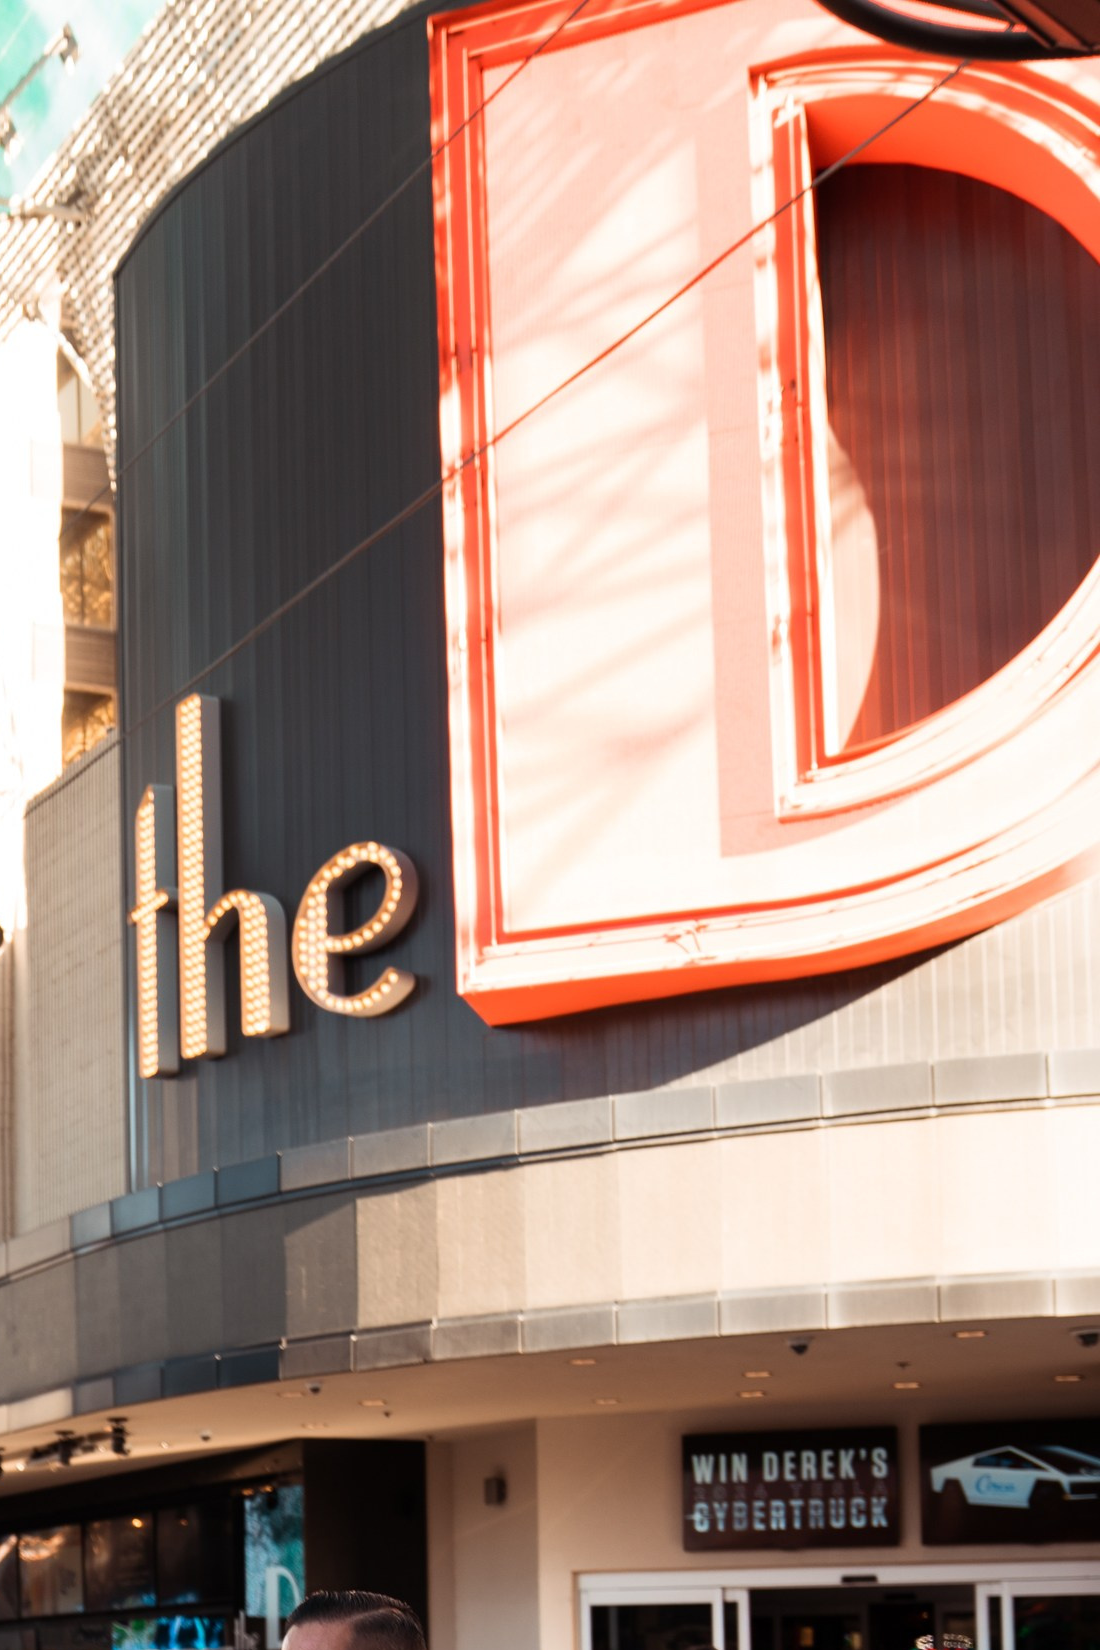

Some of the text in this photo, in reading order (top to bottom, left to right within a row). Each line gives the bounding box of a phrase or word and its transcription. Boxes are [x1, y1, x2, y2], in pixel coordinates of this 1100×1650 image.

[127, 0, 1100, 1078] the D
[691, 1447, 889, 1485] WIN DEREK'S
[693, 1496, 889, 1533] CYBERTRUCK
